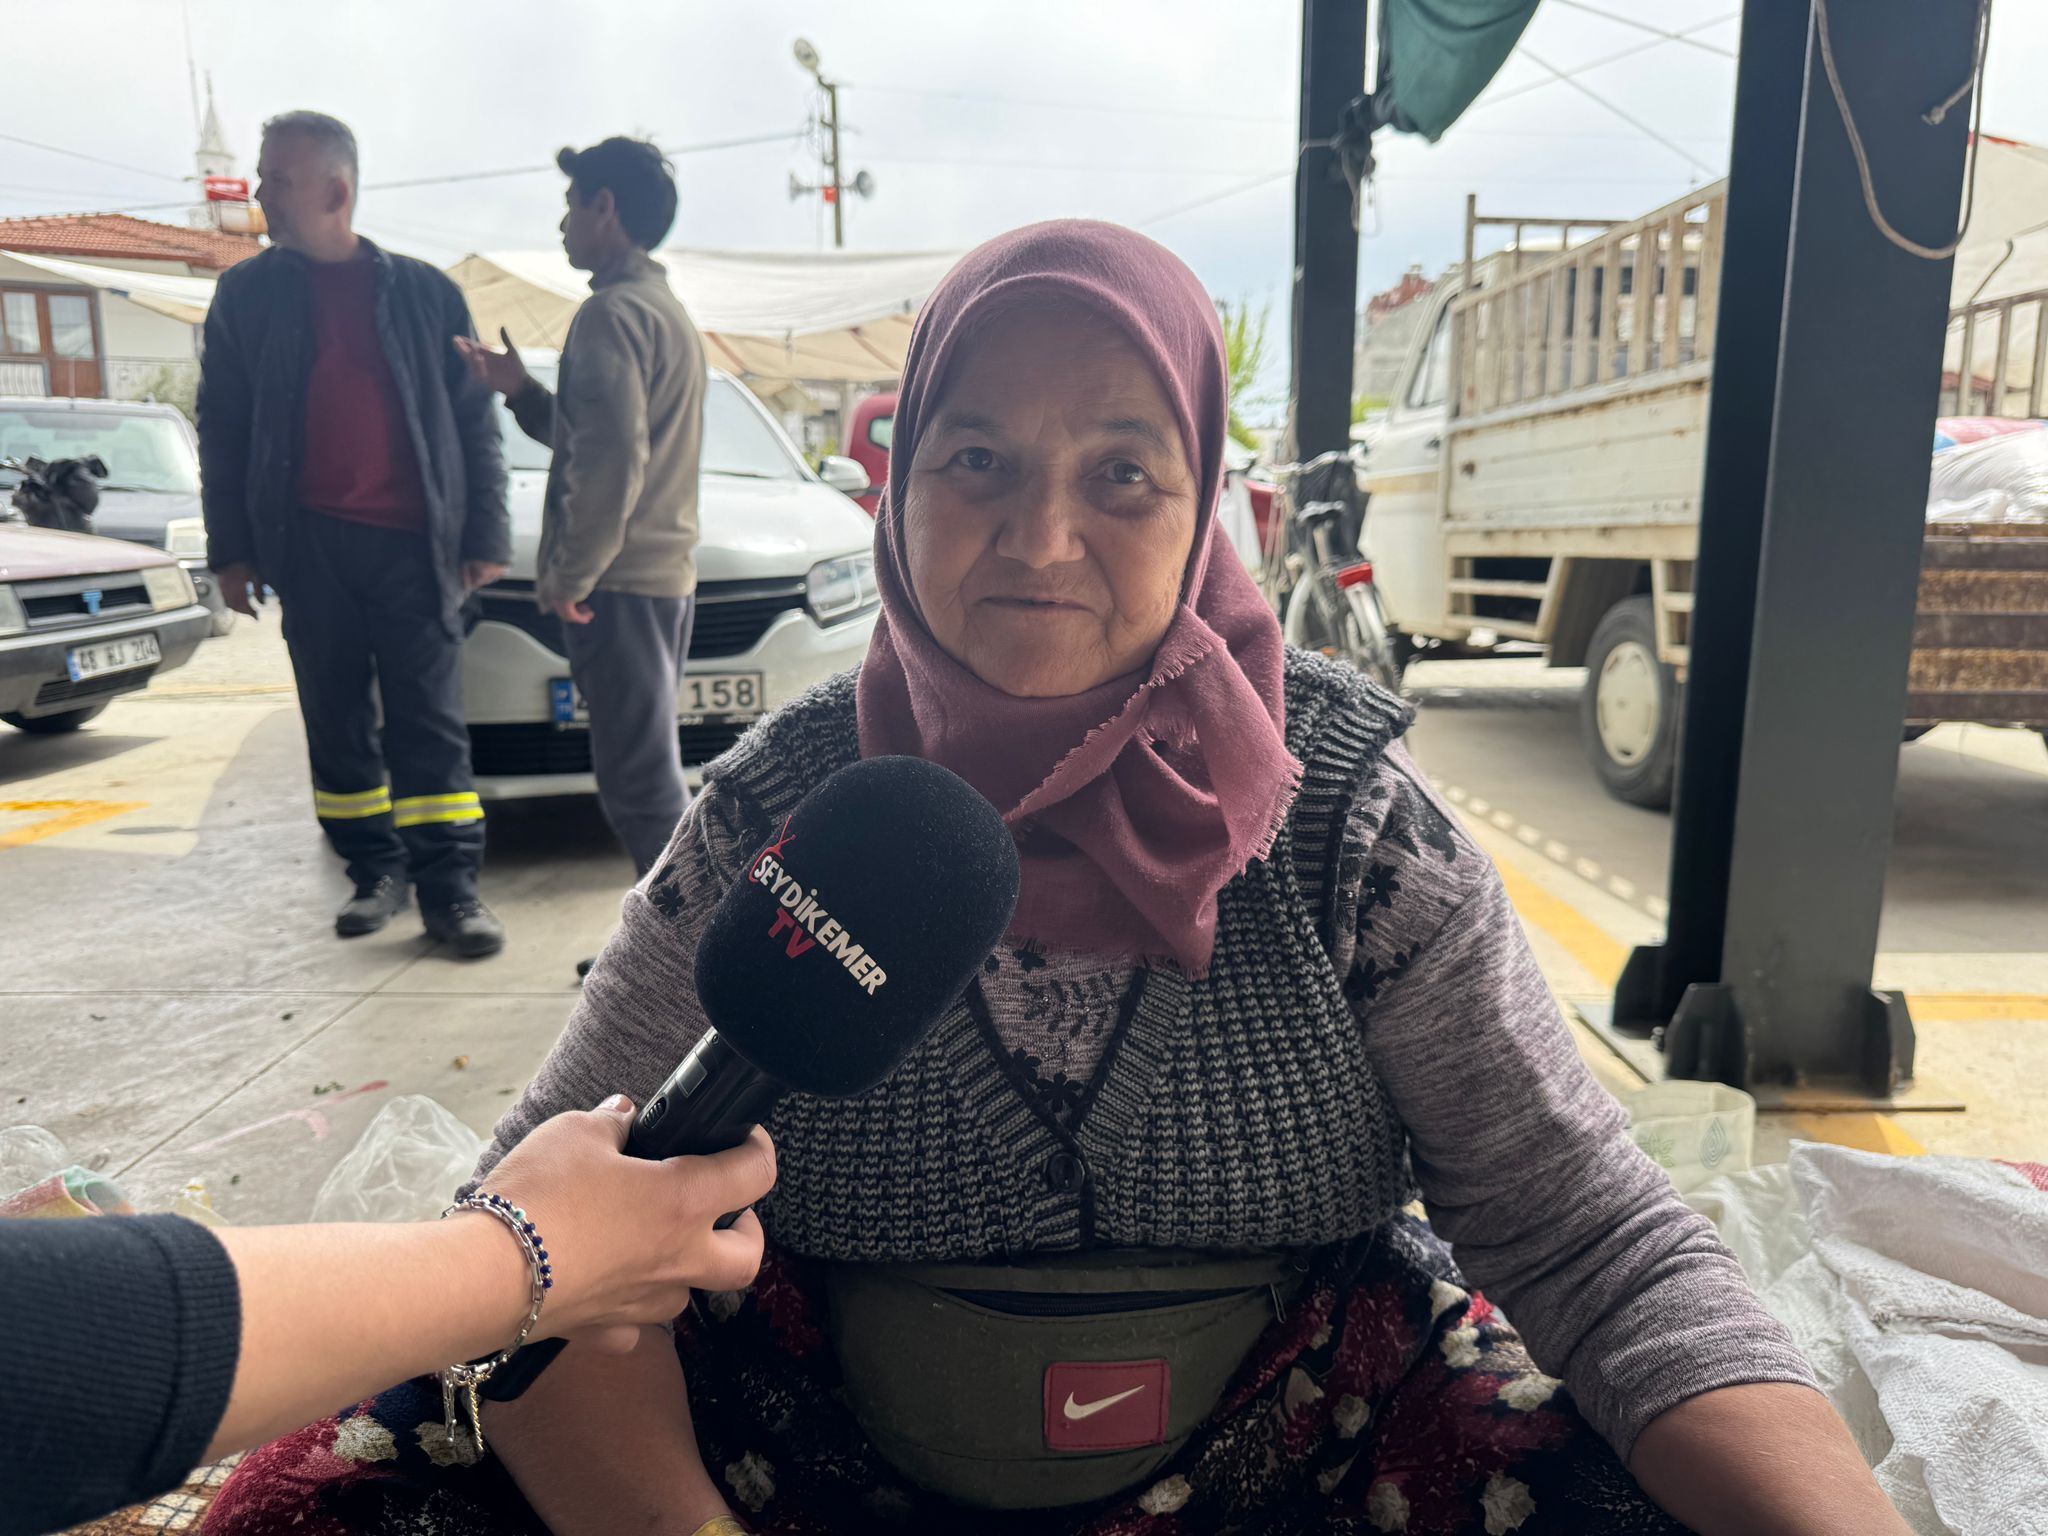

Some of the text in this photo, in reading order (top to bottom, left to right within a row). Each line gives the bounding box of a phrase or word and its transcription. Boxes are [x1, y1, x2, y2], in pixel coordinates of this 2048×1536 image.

[691, 679, 754, 709] 158
[753, 855, 887, 996] SEYDİKEMER
[767, 907, 816, 959] TV
